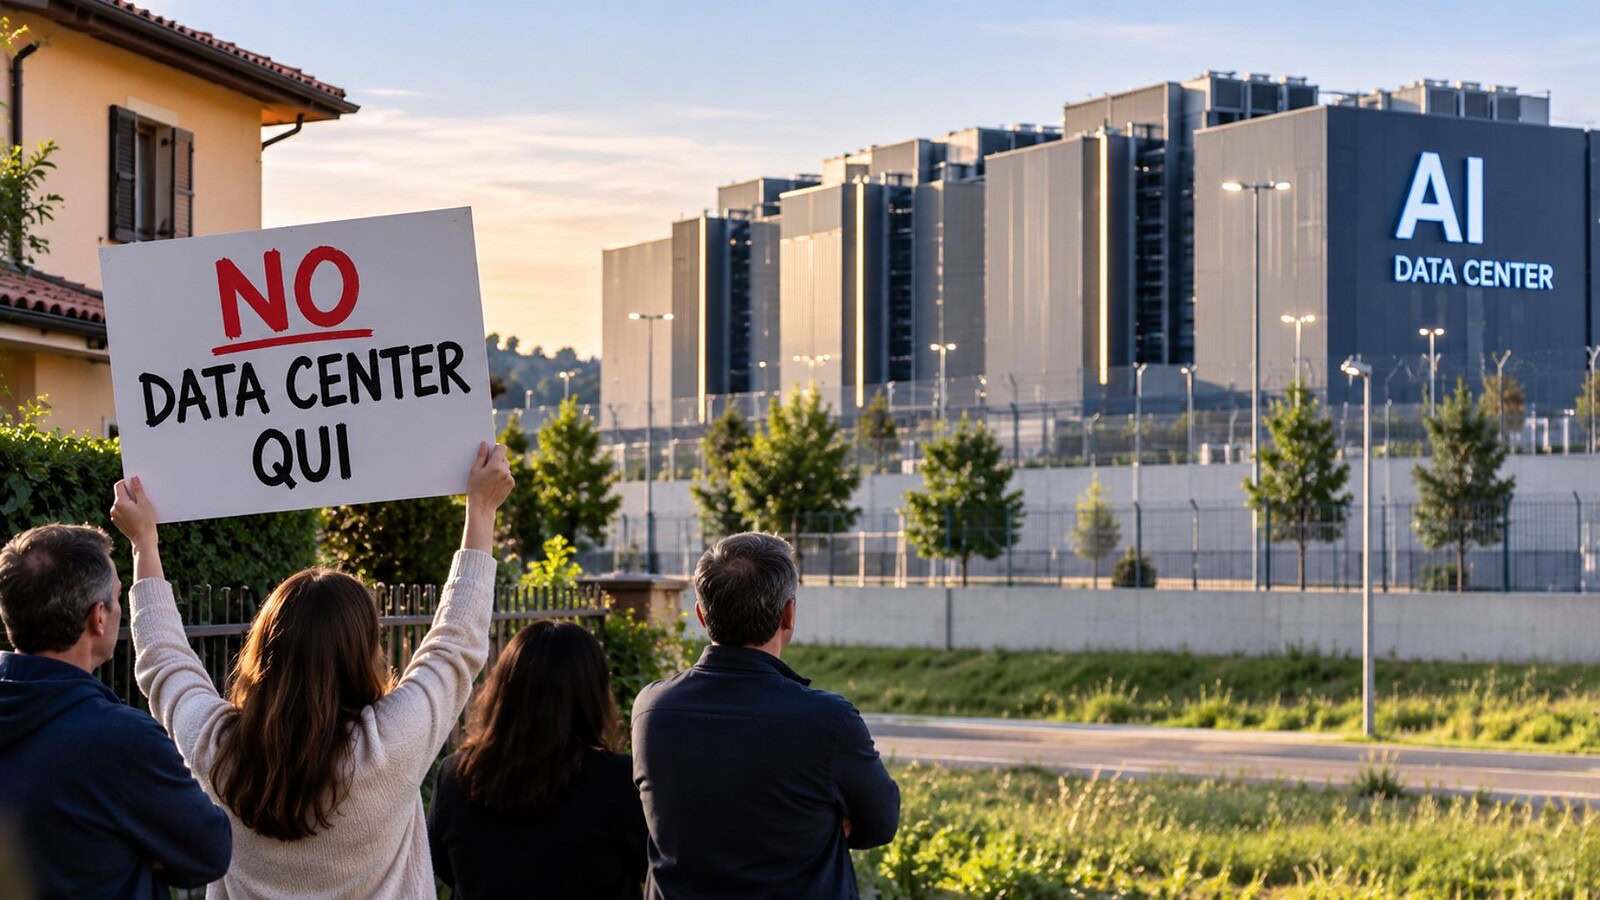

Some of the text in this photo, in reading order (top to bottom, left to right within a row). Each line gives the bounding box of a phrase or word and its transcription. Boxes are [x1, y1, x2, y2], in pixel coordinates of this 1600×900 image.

[1395, 151, 1484, 244] AI
[215, 245, 360, 339] NO
[1394, 255, 1554, 290] DATA CENTER
[138, 340, 472, 428] DATA CENTER
[252, 422, 352, 490] QUI
